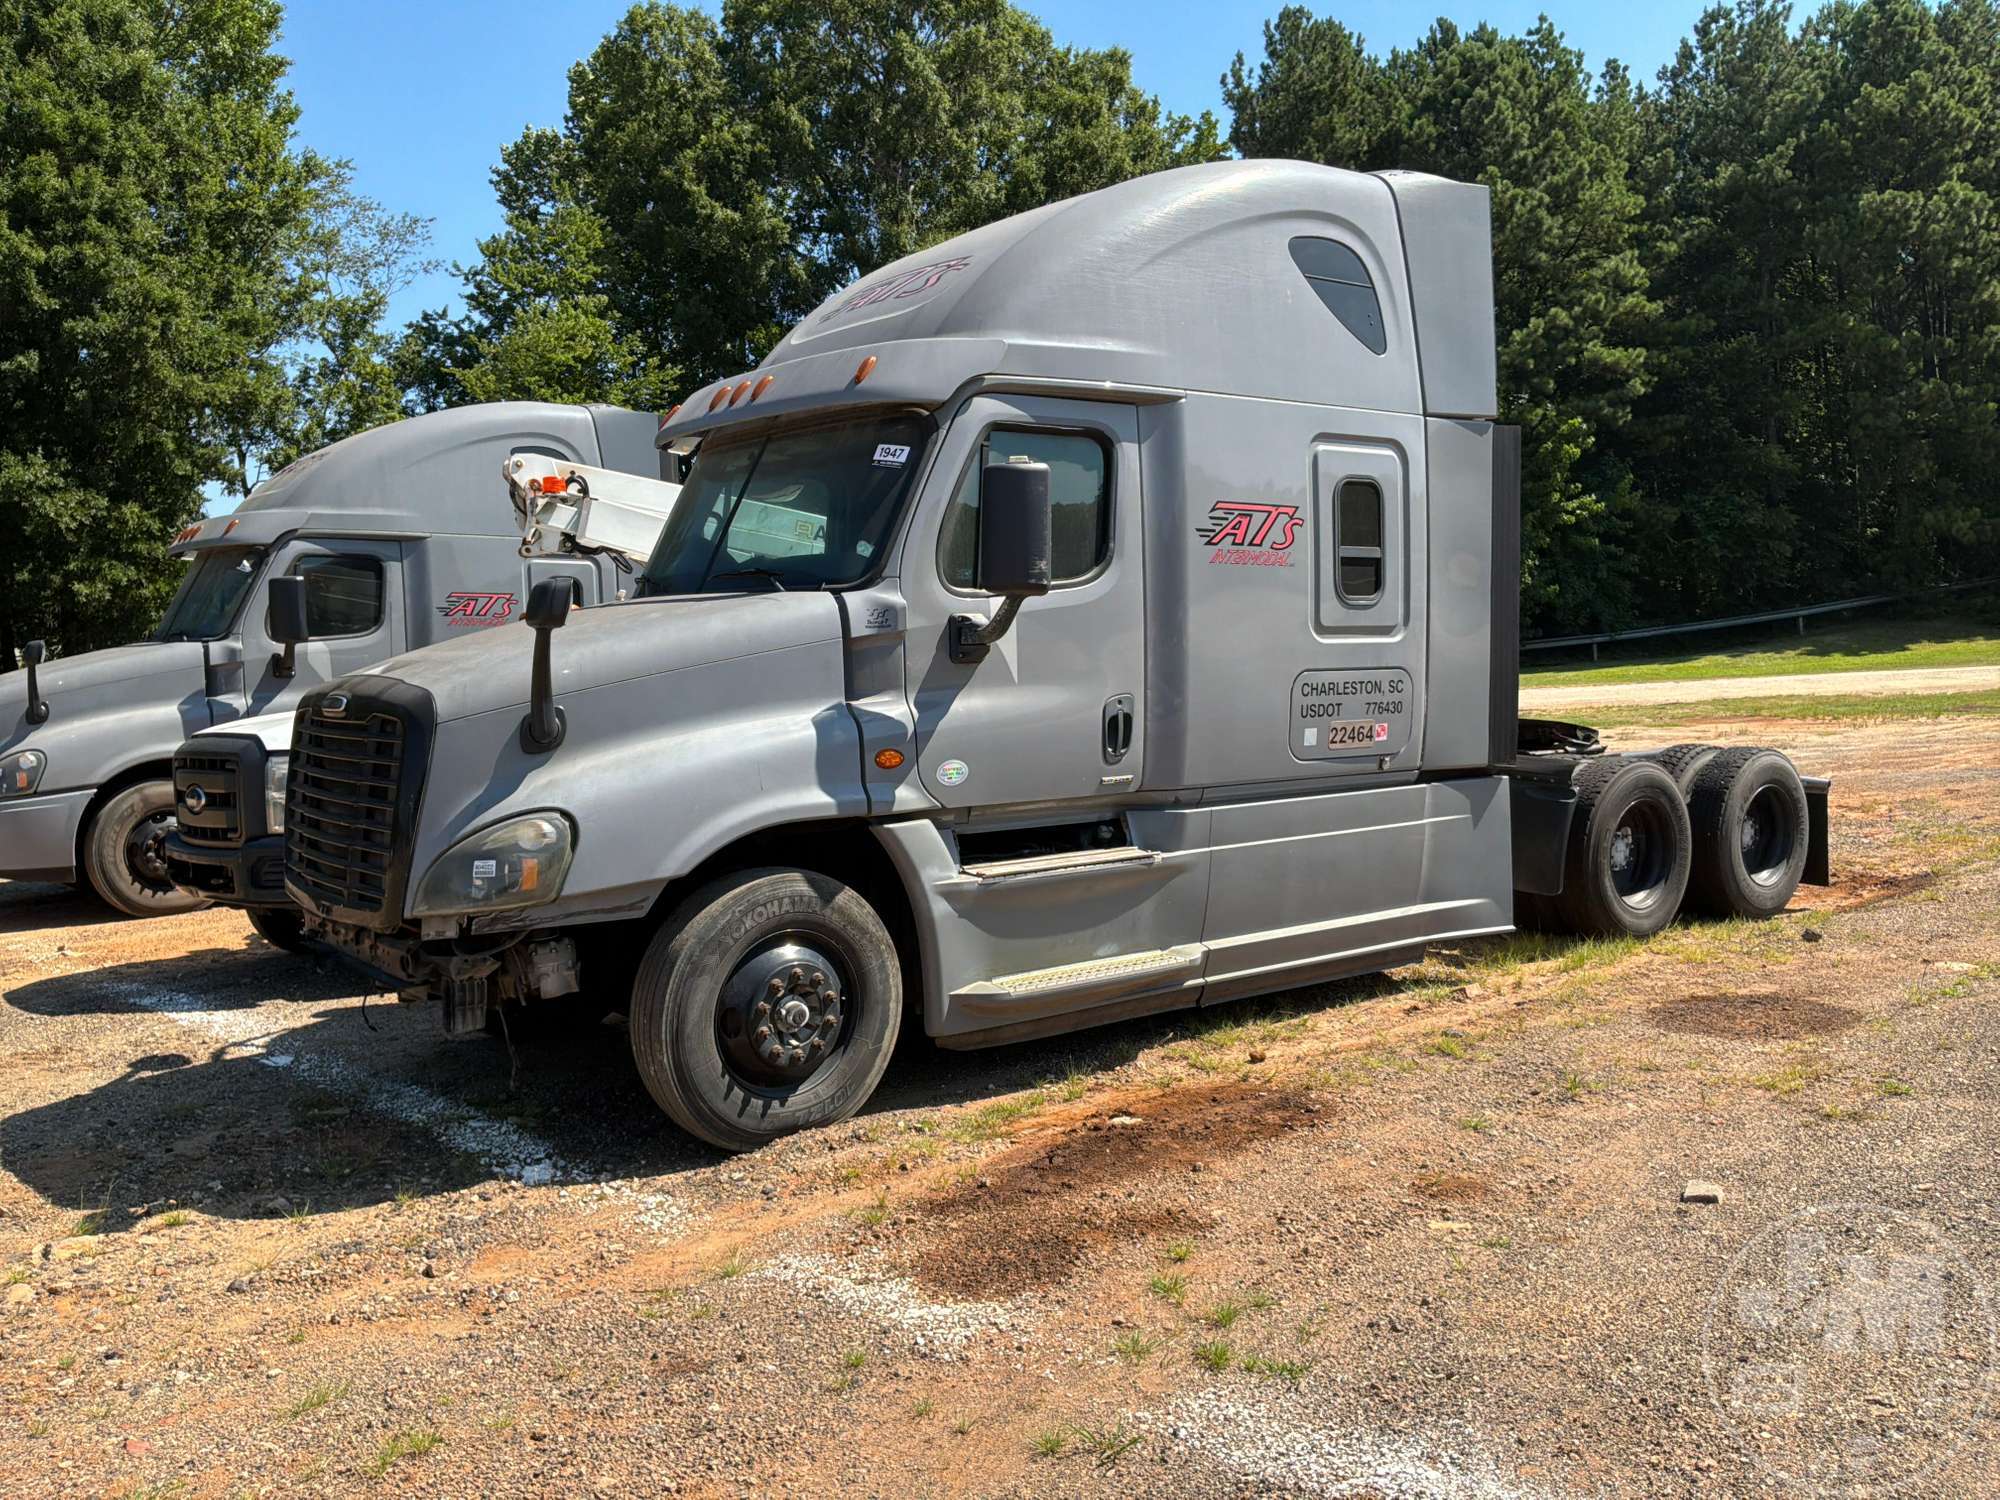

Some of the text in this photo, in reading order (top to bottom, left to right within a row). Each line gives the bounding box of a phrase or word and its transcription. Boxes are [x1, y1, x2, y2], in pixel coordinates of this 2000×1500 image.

[879, 446, 905, 459] 1947
[1208, 548, 1291, 567] INTERMODAL
[1300, 679, 1404, 697] CHARLESTON, SC
[1300, 701, 1403, 718] USDOT 776430
[1329, 725, 1374, 744] 22464
